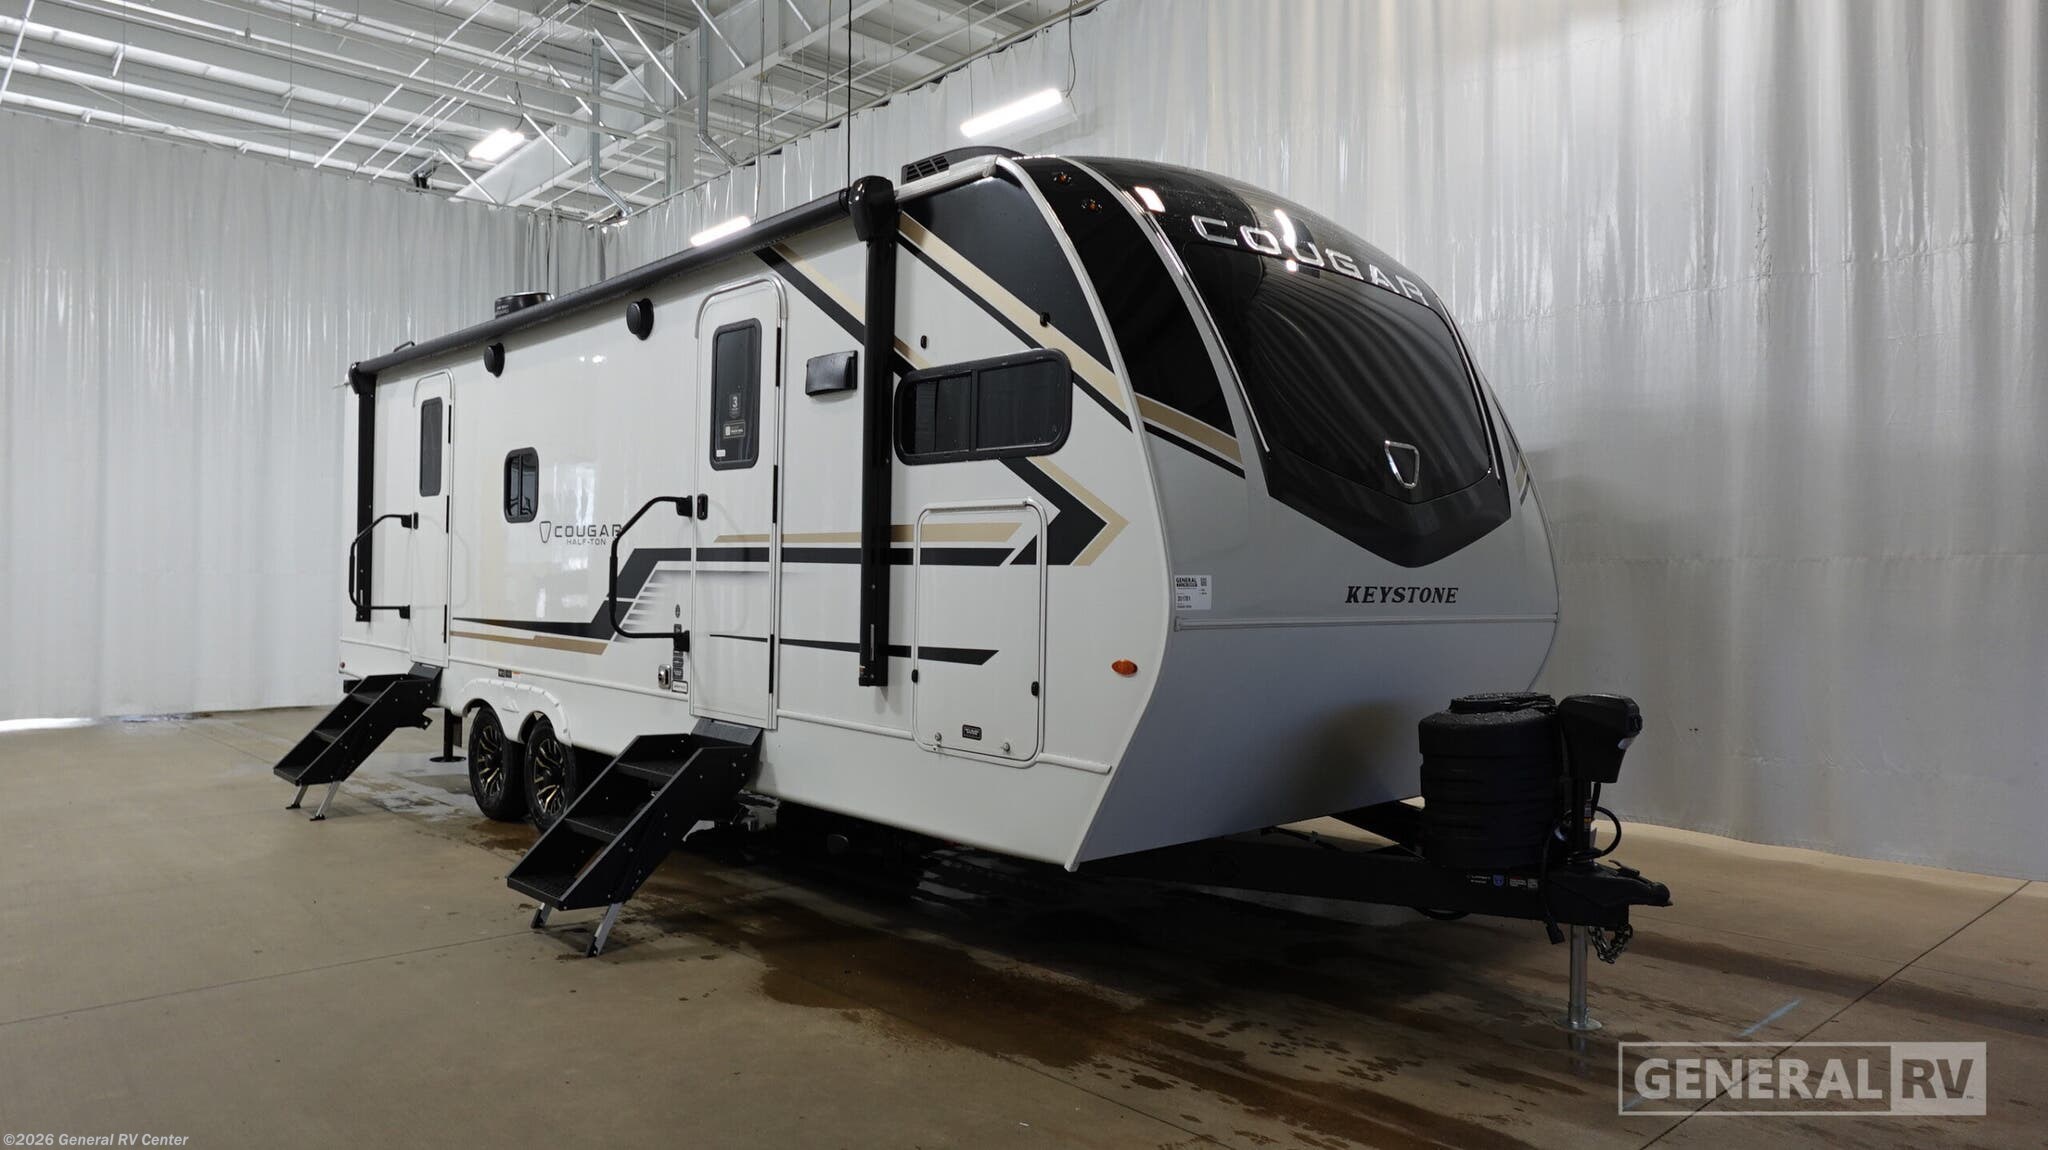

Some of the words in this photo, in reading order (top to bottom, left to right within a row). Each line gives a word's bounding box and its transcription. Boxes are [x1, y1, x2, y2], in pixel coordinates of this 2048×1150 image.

[1191, 214, 1431, 306] COUGAR
[566, 537, 607, 546] HALF-TON
[1345, 585, 1459, 604] KEYSTONE
